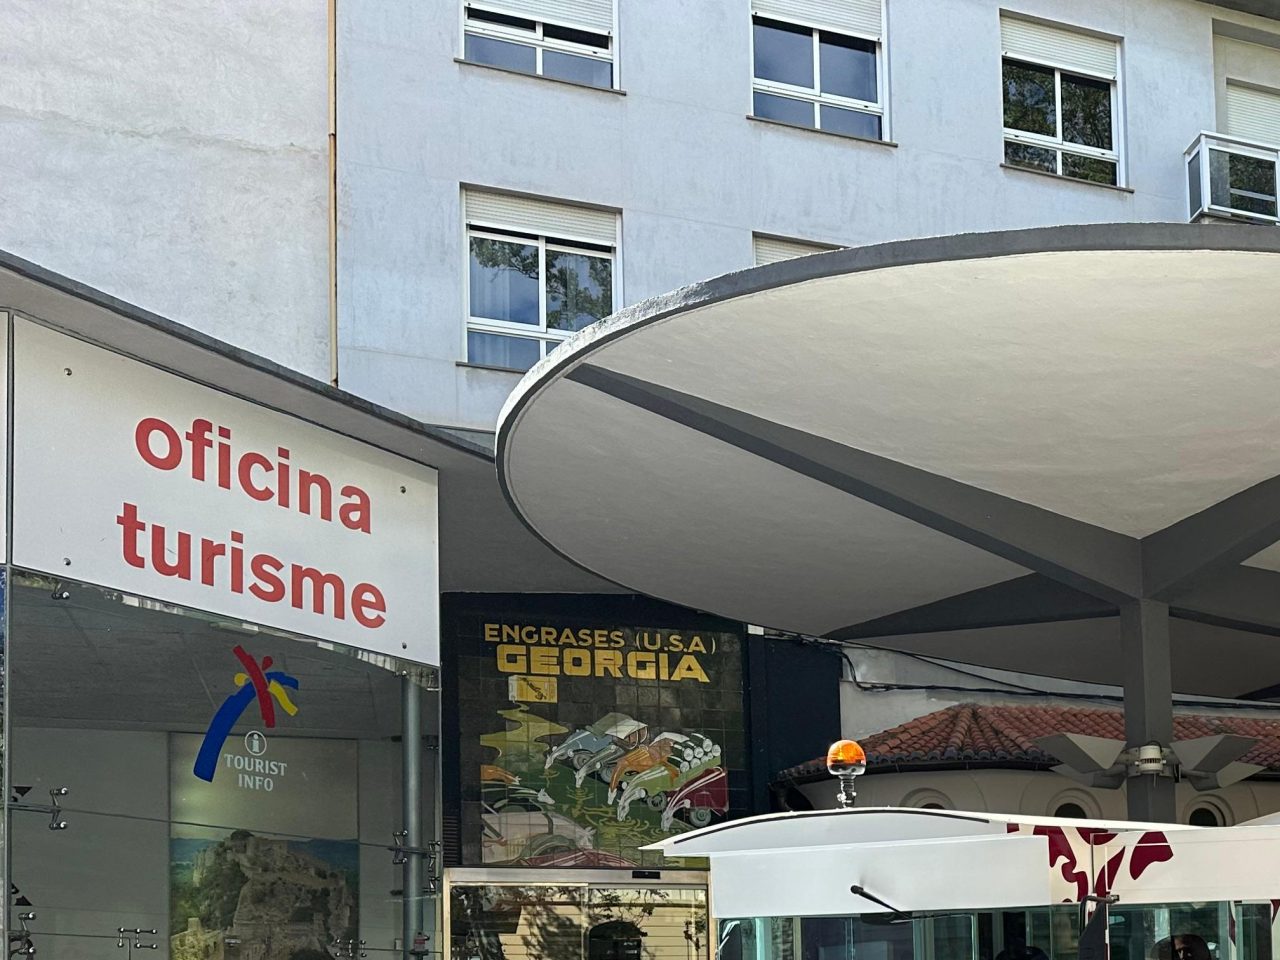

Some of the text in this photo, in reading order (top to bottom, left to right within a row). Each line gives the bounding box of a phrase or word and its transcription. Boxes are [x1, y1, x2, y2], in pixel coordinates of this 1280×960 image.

[135, 417, 372, 535] oficina
[116, 503, 387, 629] turisme
[484, 623, 625, 648] ENGRASES
[497, 644, 711, 683] GEORGIA
[224, 753, 287, 776] TOURIST
[238, 773, 273, 792] INFO
